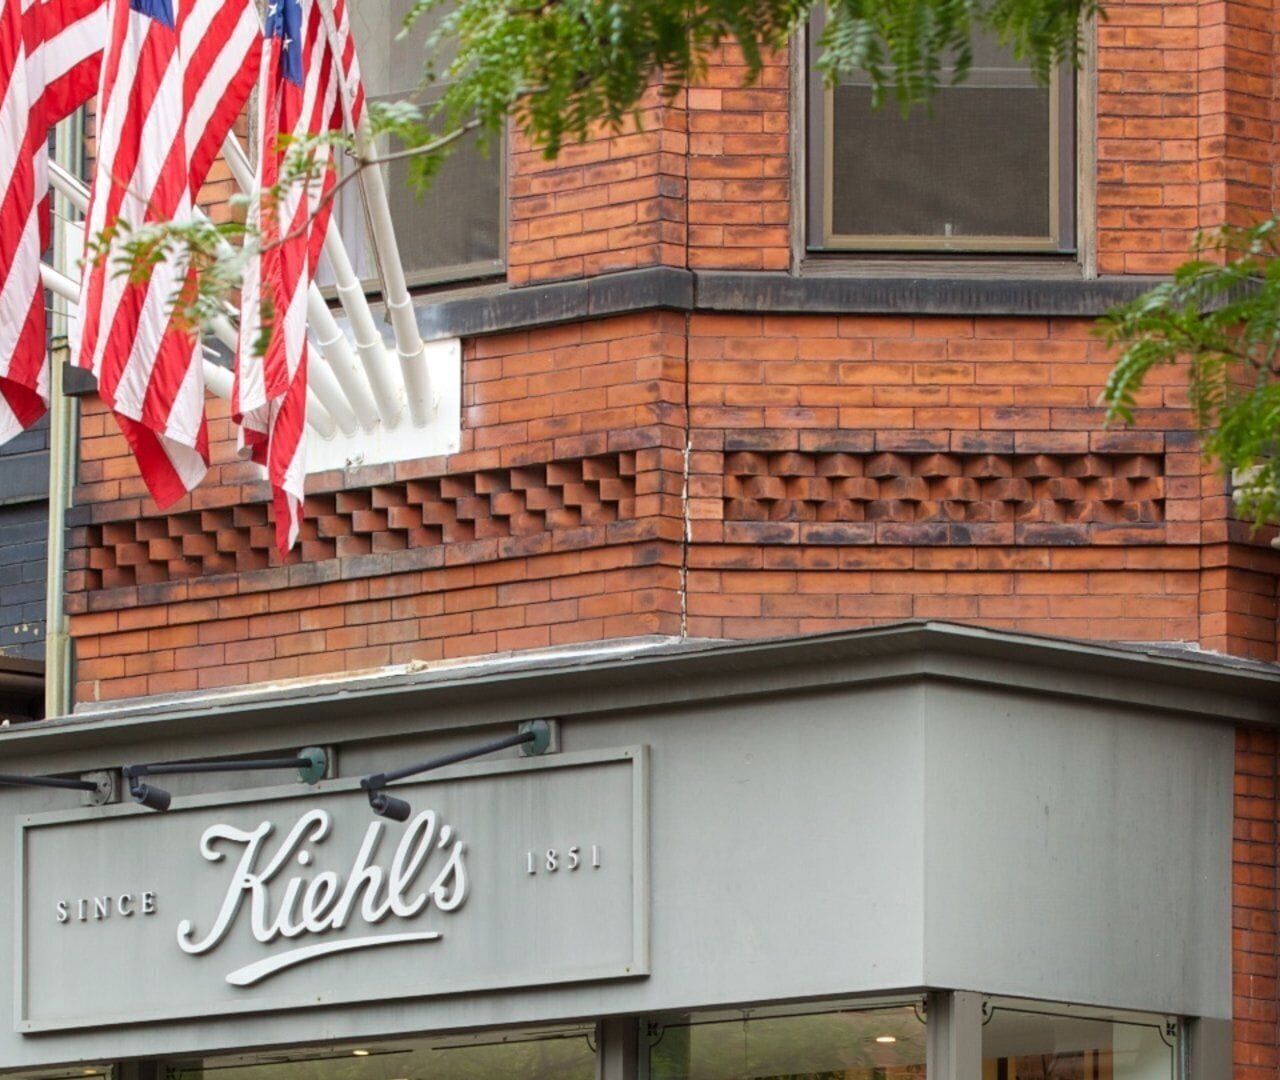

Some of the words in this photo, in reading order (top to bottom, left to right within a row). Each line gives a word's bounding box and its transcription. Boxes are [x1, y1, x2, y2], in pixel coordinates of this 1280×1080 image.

[524, 844, 602, 875] 1851
[177, 808, 470, 964] Kiehl's
[56, 890, 156, 923] SINCE
